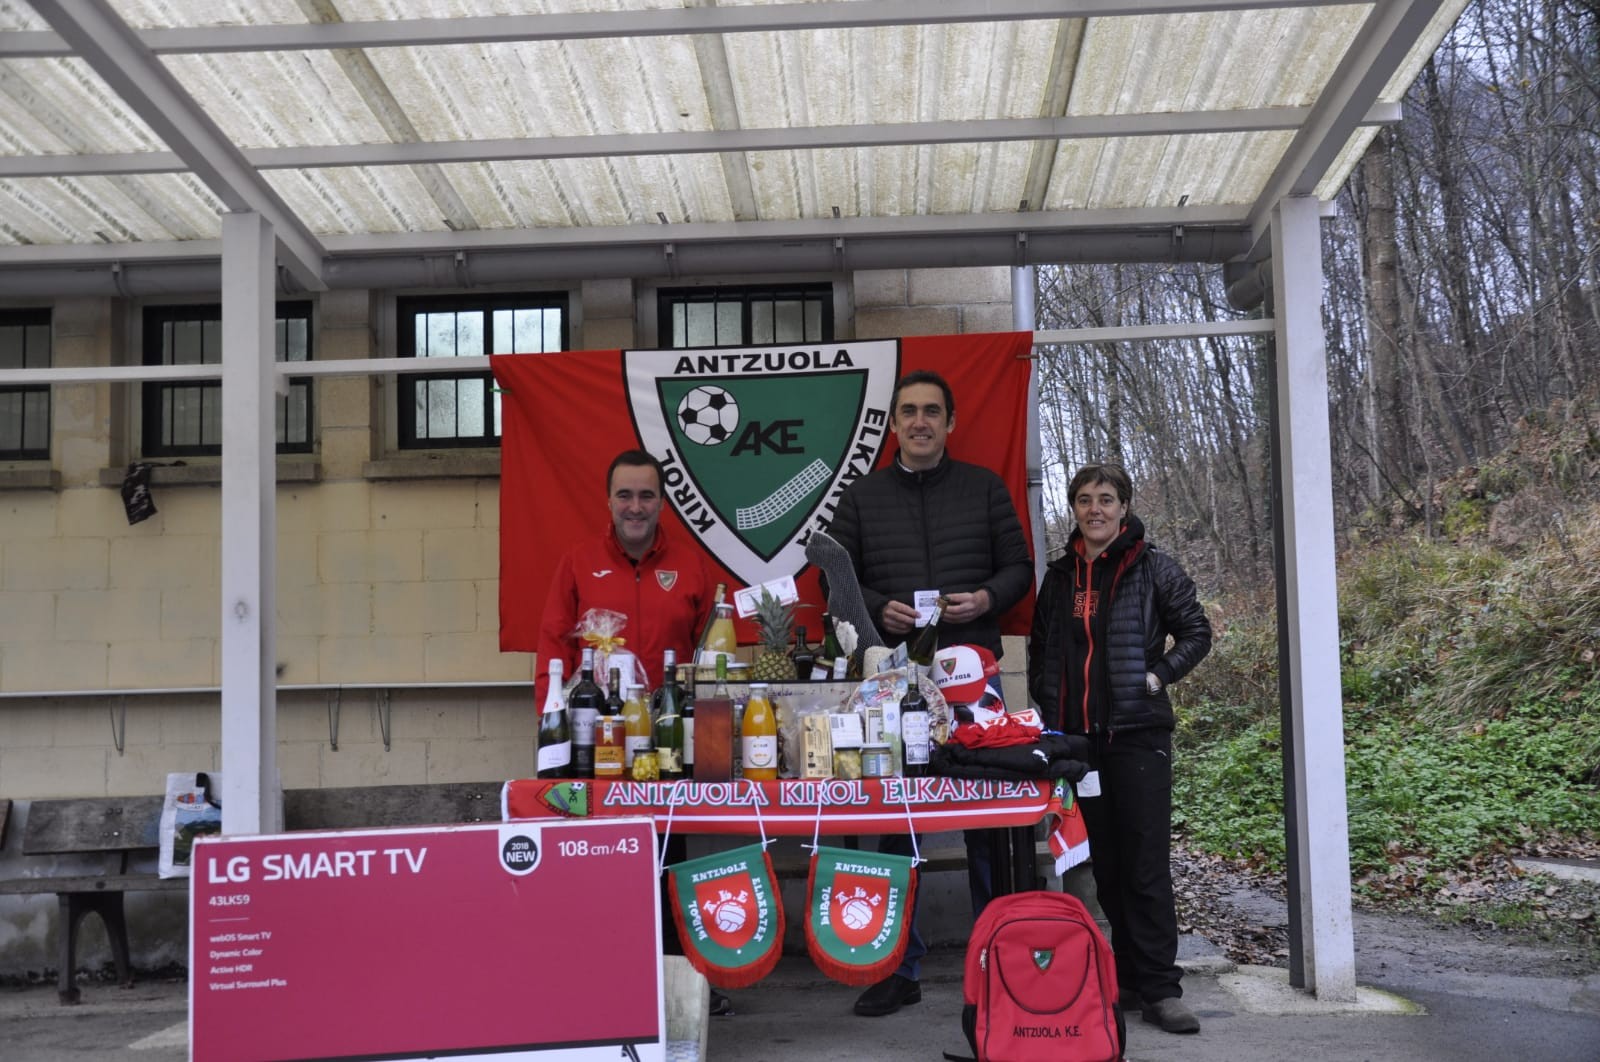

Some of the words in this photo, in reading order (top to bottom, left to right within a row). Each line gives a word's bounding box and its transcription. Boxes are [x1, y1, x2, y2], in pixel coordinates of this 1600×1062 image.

[674, 349, 854, 374] ANTZUOLA
[730, 419, 804, 456] AKE
[661, 448, 716, 533] KIROL
[604, 781, 769, 806] ANTZUOLA
[780, 780, 868, 805] KIROL
[882, 777, 1039, 804] ELKARTEA
[511, 842, 529, 850] 2018
[558, 840, 588, 857] 108
[506, 850, 536, 863] NEW
[208, 857, 250, 884] LG
[263, 850, 376, 881] SMART
[384, 848, 427, 874] TV
[691, 861, 748, 883] ANTZUOLA
[834, 862, 891, 877] ANTZUOLA
[209, 894, 250, 906] 43LK59
[210, 933, 236, 943] webOS
[237, 933, 260, 942] Smart
[261, 931, 272, 940] TV
[210, 950, 241, 960] Dynamic
[242, 948, 263, 957] Color
[210, 966, 234, 975] Active
[235, 964, 253, 973] HDR
[209, 981, 235, 991] Virtual
[236, 979, 270, 989] Surround
[271, 978, 287, 987] Plus
[1013, 1026, 1062, 1038] ANTZUOLA
